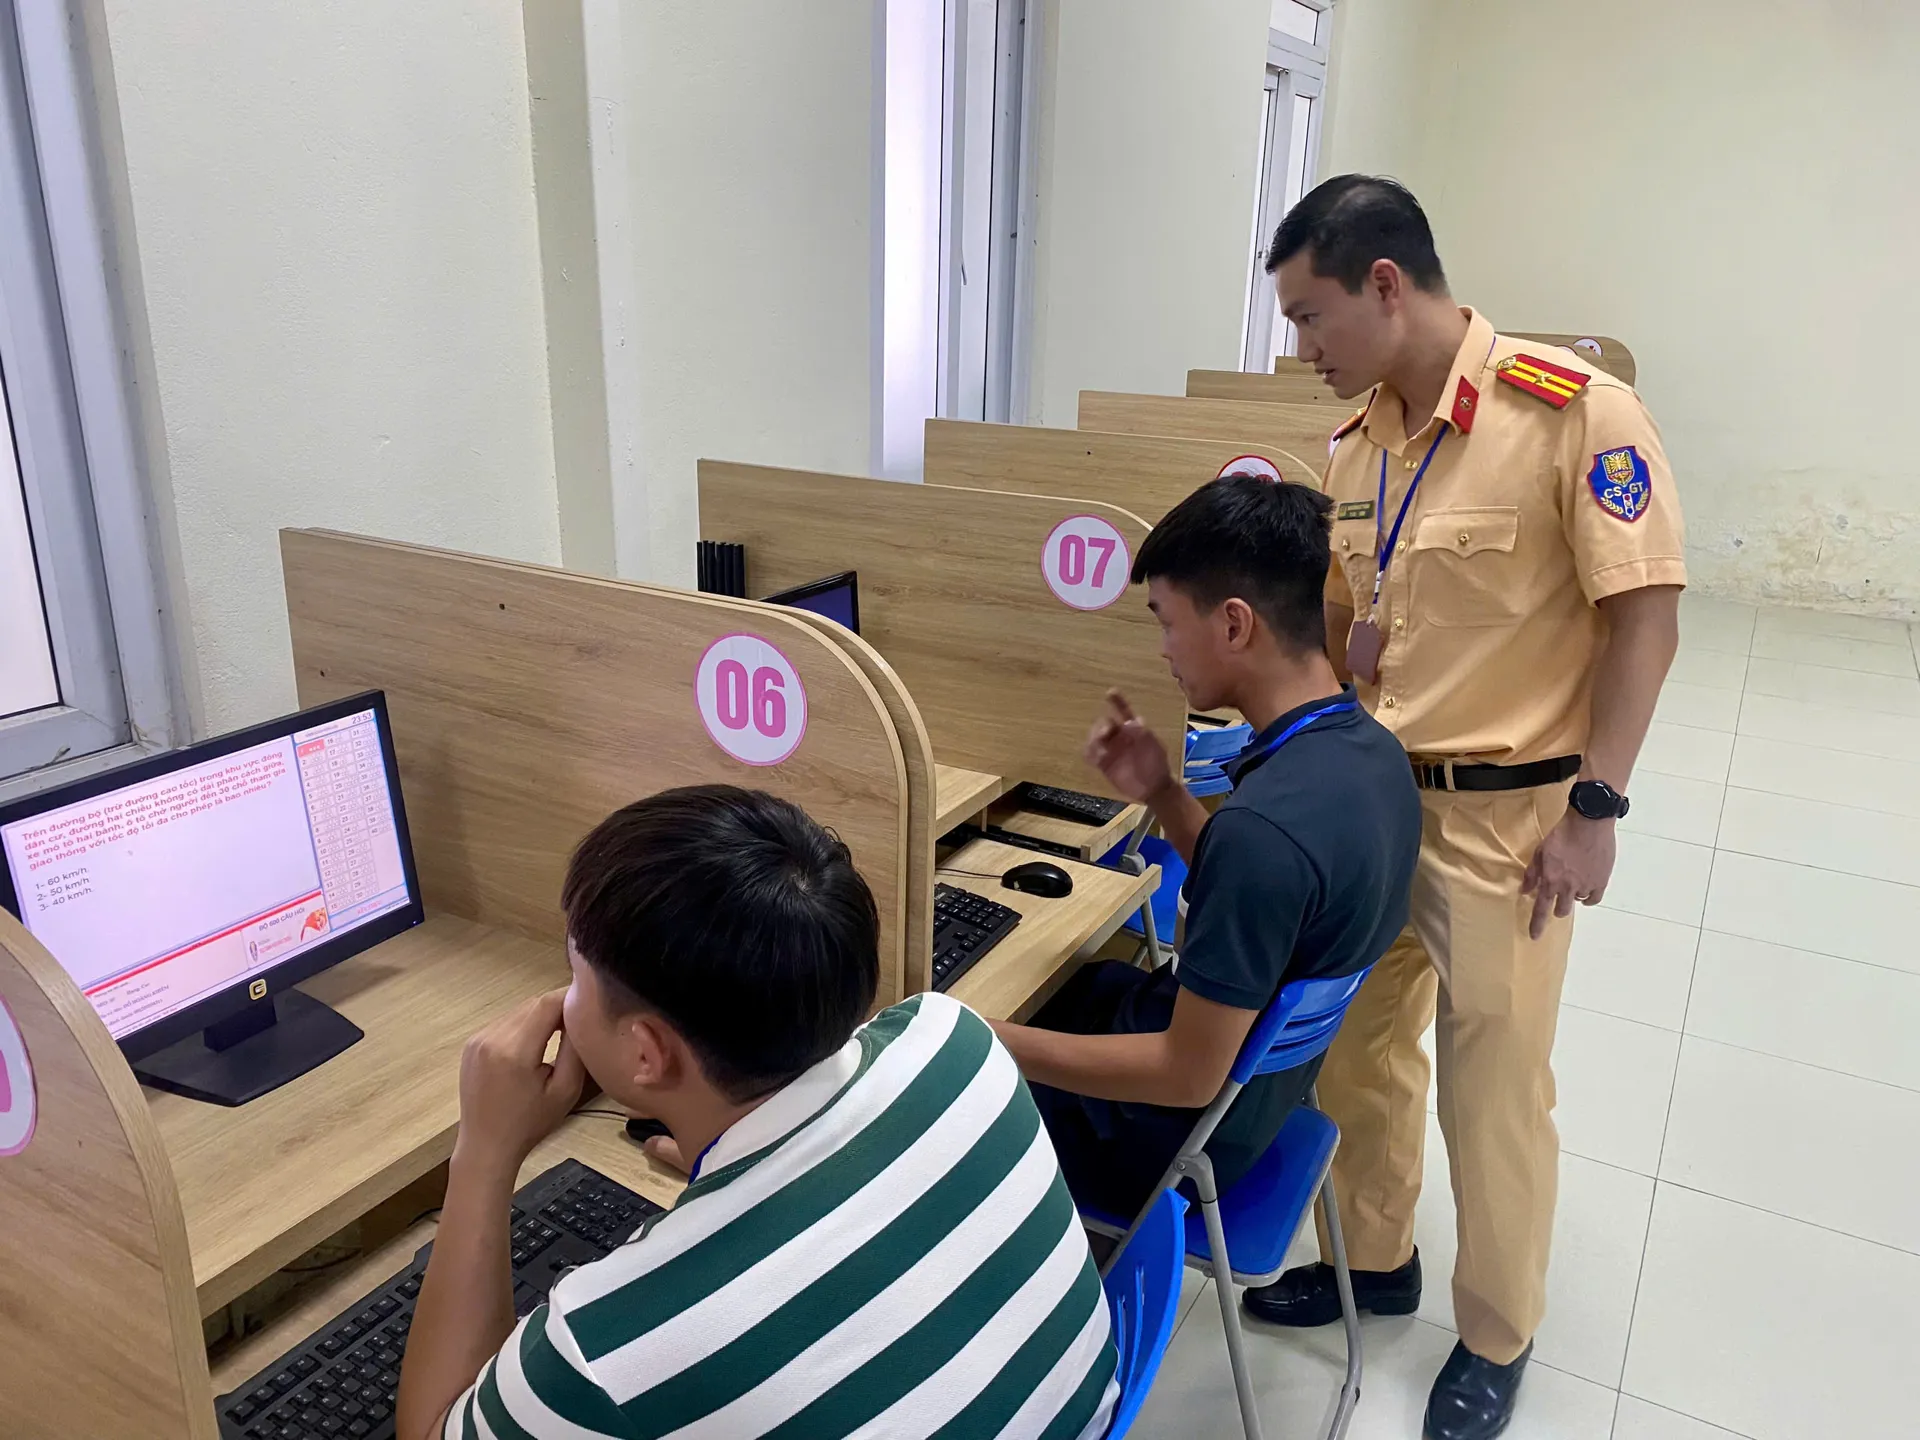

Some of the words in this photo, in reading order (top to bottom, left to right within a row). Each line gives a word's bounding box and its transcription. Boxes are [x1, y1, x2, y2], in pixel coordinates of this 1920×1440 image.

[1604, 486, 1622, 498] CS
[1629, 482, 1643, 493] GT
[1058, 534, 1116, 588] 07
[715, 658, 787, 738] 06
[22, 829, 47, 841] Trên
[87, 810, 101, 819] bộ
[125, 792, 159, 807] đường
[160, 786, 178, 796] cao
[179, 778, 198, 789] tốc)
[199, 771, 224, 783] trong
[225, 765, 241, 774] khu
[243, 759, 260, 768] vực
[27, 852, 40, 860] xe
[76, 832, 93, 843] hai
[219, 786, 230, 795] 30
[250, 773, 271, 784] tham
[273, 768, 286, 777] gia
[107, 814, 123, 823] hai
[154, 793, 184, 807] không
[186, 788, 199, 797] có
[29, 858, 53, 871] giao
[126, 827, 139, 836] độ
[170, 811, 188, 821] cho
[225, 792, 242, 802] bao
[47, 876, 60, 886] 60
[50, 886, 63, 896] 50
[52, 896, 65, 905] 40
